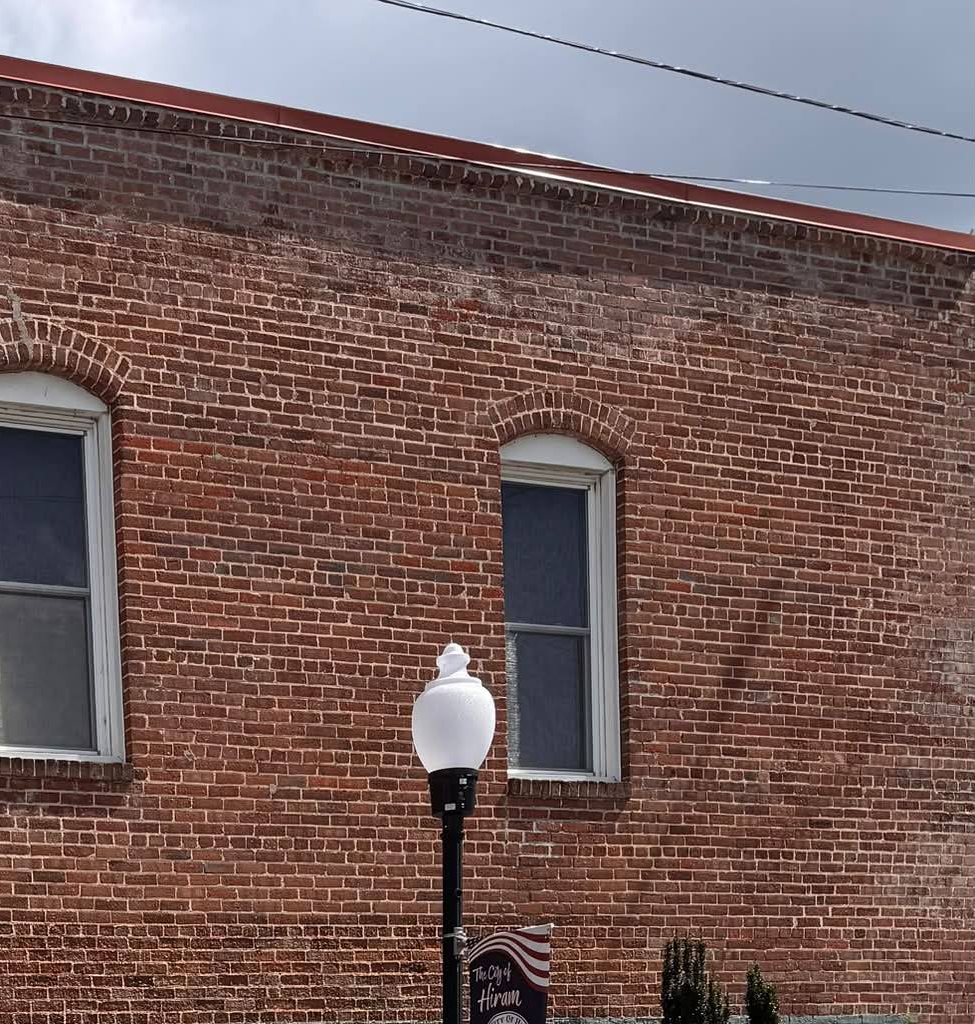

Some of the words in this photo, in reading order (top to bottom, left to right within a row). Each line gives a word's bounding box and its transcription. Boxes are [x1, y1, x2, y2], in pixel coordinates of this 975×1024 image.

[472, 965, 488, 983] The
[487, 964, 503, 986] City
[503, 962, 513, 982] of
[477, 982, 522, 1013] Hiram
